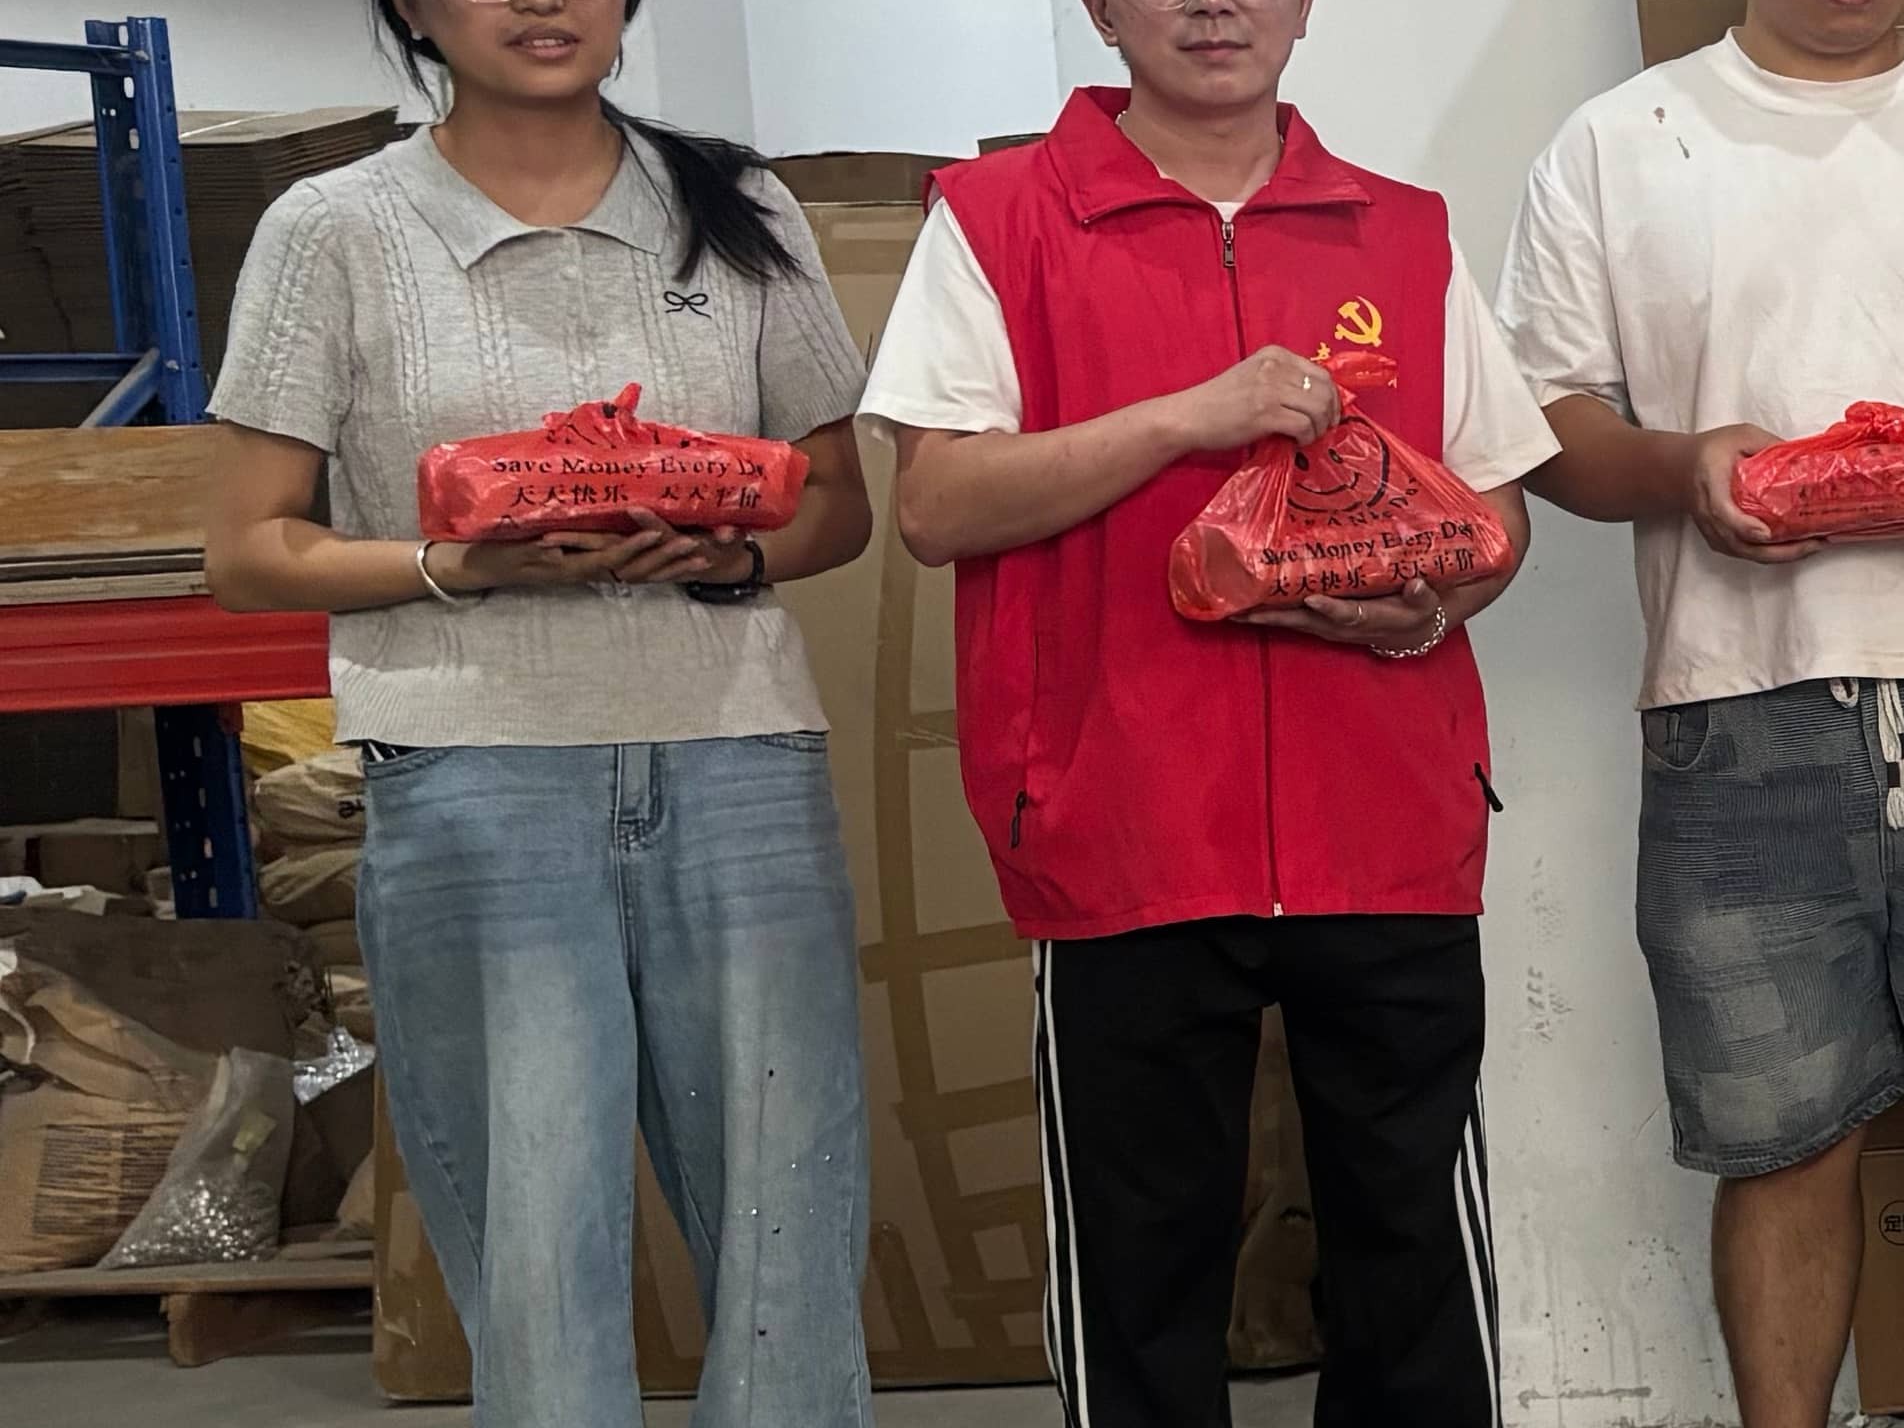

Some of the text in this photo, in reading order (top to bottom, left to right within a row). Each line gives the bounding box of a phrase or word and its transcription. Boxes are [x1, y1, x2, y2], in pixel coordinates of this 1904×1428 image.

[562, 457, 650, 479] Money
[661, 455, 731, 478] Every
[511, 482, 629, 507] 天天快乐
[1306, 538, 1377, 562] Money
